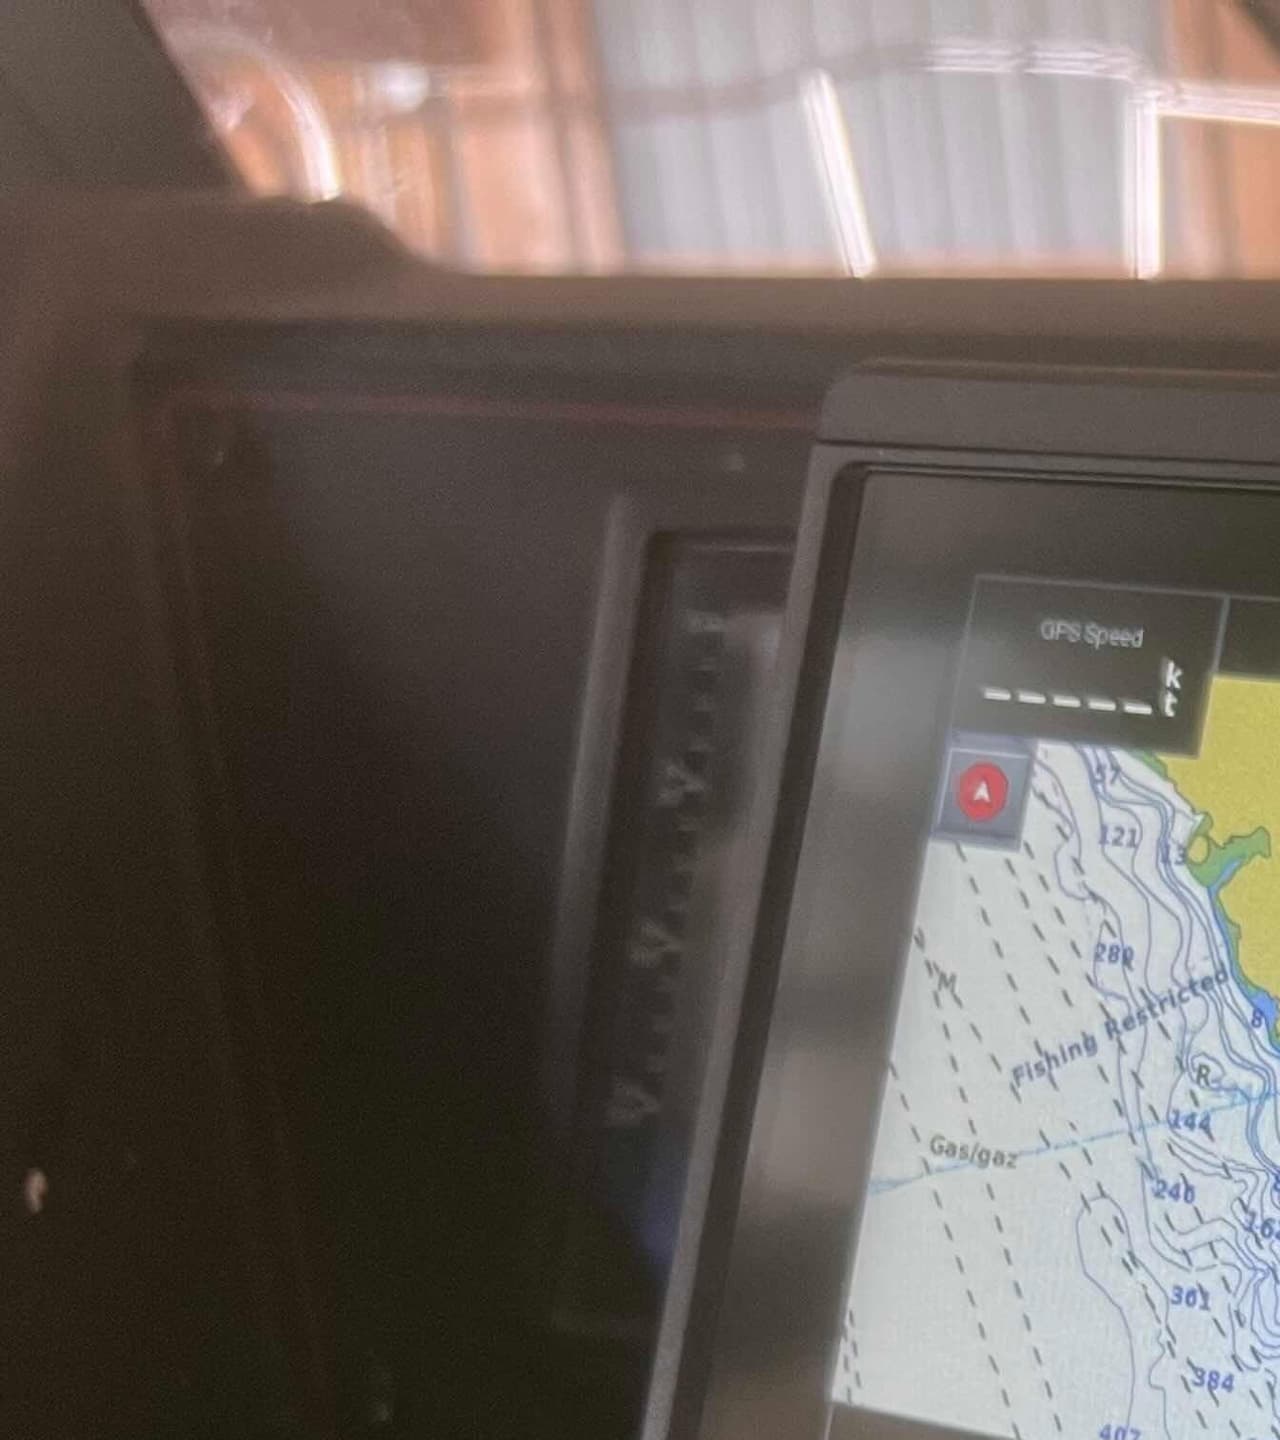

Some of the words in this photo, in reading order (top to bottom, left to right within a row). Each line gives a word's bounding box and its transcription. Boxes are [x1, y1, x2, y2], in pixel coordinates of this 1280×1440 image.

[1040, 619, 1081, 642] GPS
[1084, 624, 1144, 649] Speed
[1011, 1031, 1098, 1088] Fishing
[1105, 964, 1229, 1038] Restricted
[930, 1134, 1018, 1170] Gas/gaz
